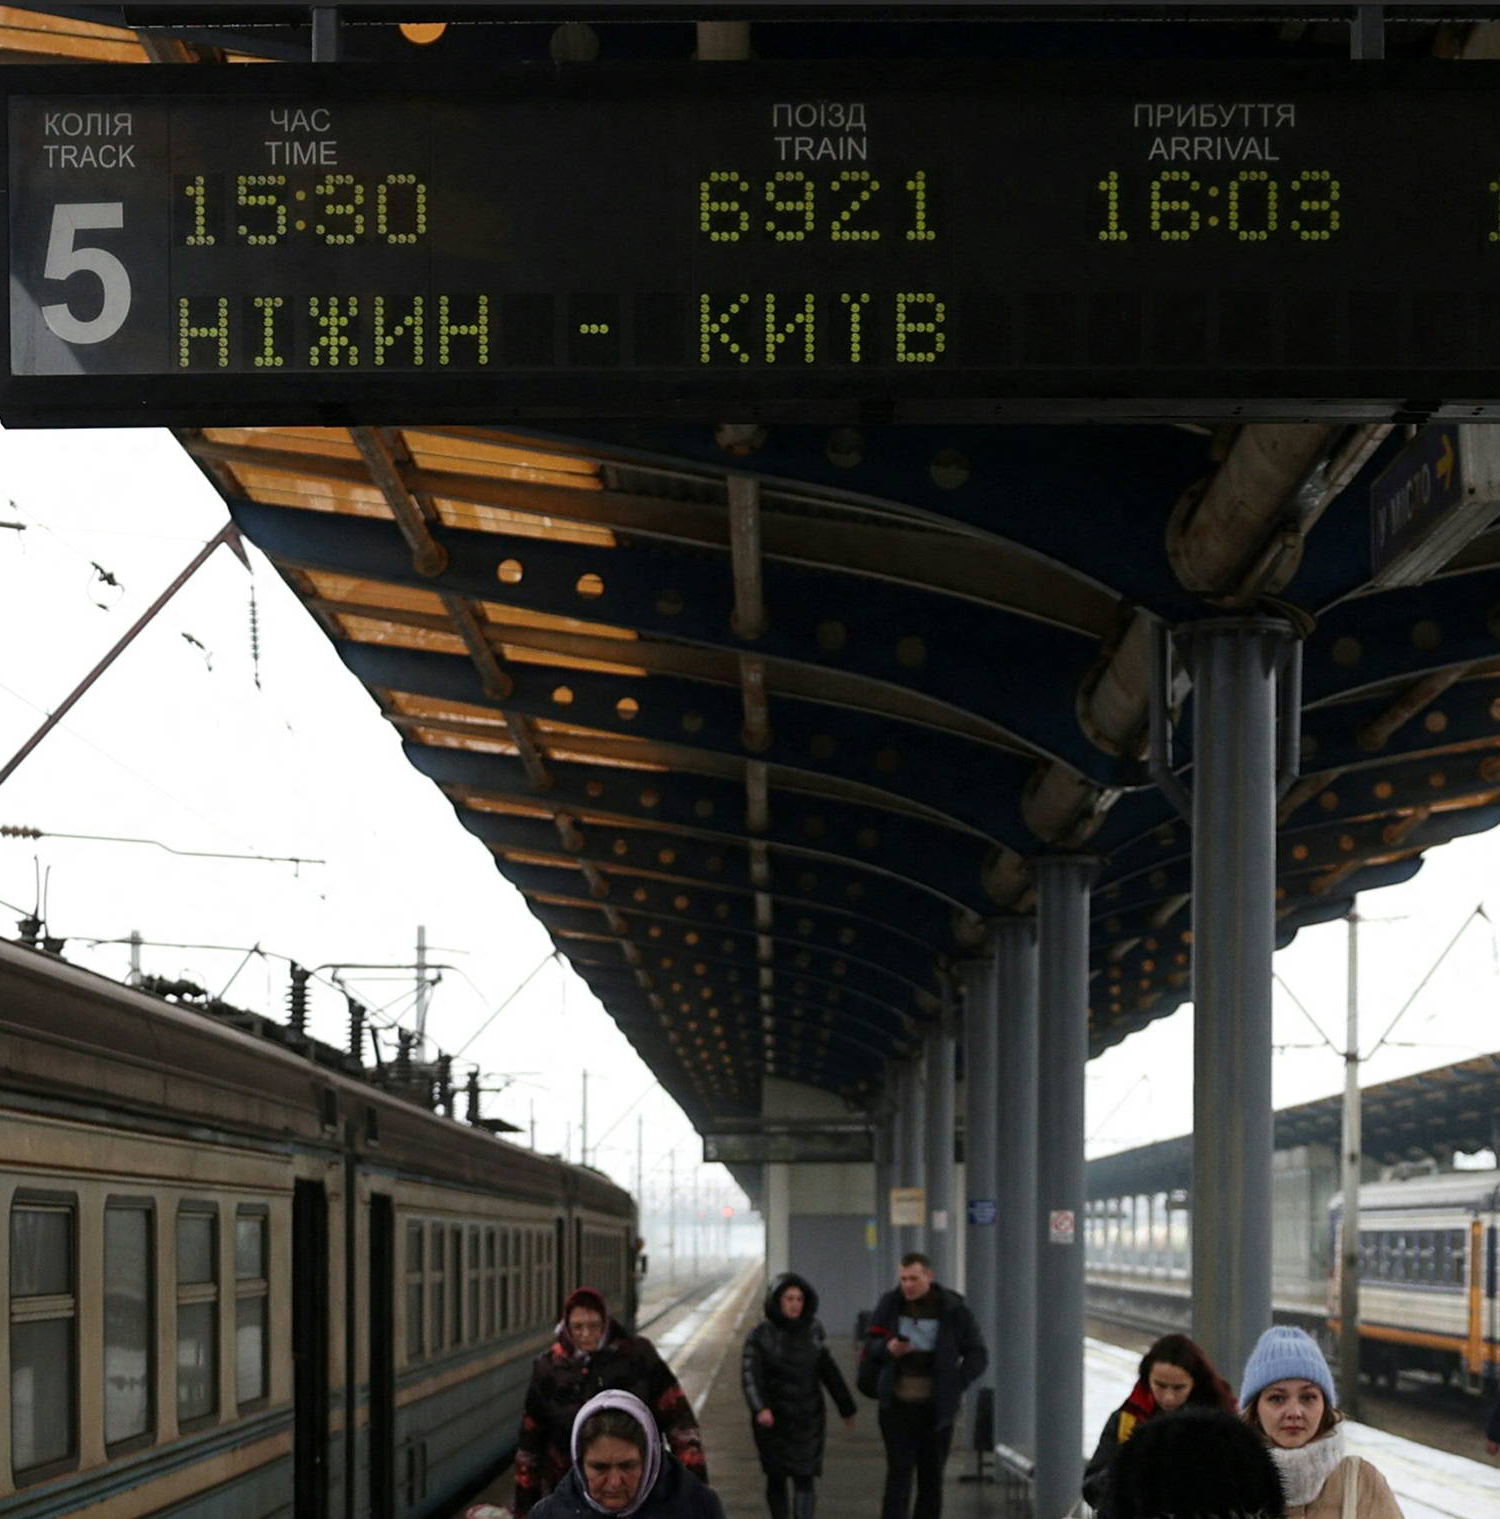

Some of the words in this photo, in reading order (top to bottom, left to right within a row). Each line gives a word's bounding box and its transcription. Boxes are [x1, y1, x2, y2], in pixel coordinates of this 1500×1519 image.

[45, 112, 132, 137] КОЛІЯ
[270, 108, 331, 132] ЧАС
[772, 101, 867, 132] ПОЇЗД
[1133, 103, 1295, 128] ПРИБУТТЯ
[43, 144, 136, 169] TRACK
[264, 140, 338, 166] TIME
[774, 136, 867, 161] TRAIN
[1148, 136, 1280, 161] ARRIVAL
[185, 174, 427, 246] 15:30
[700, 170, 936, 242] 6921
[1098, 170, 1340, 241] 16:03
[41, 202, 132, 345] 5
[179, 295, 489, 367] НІЖИН
